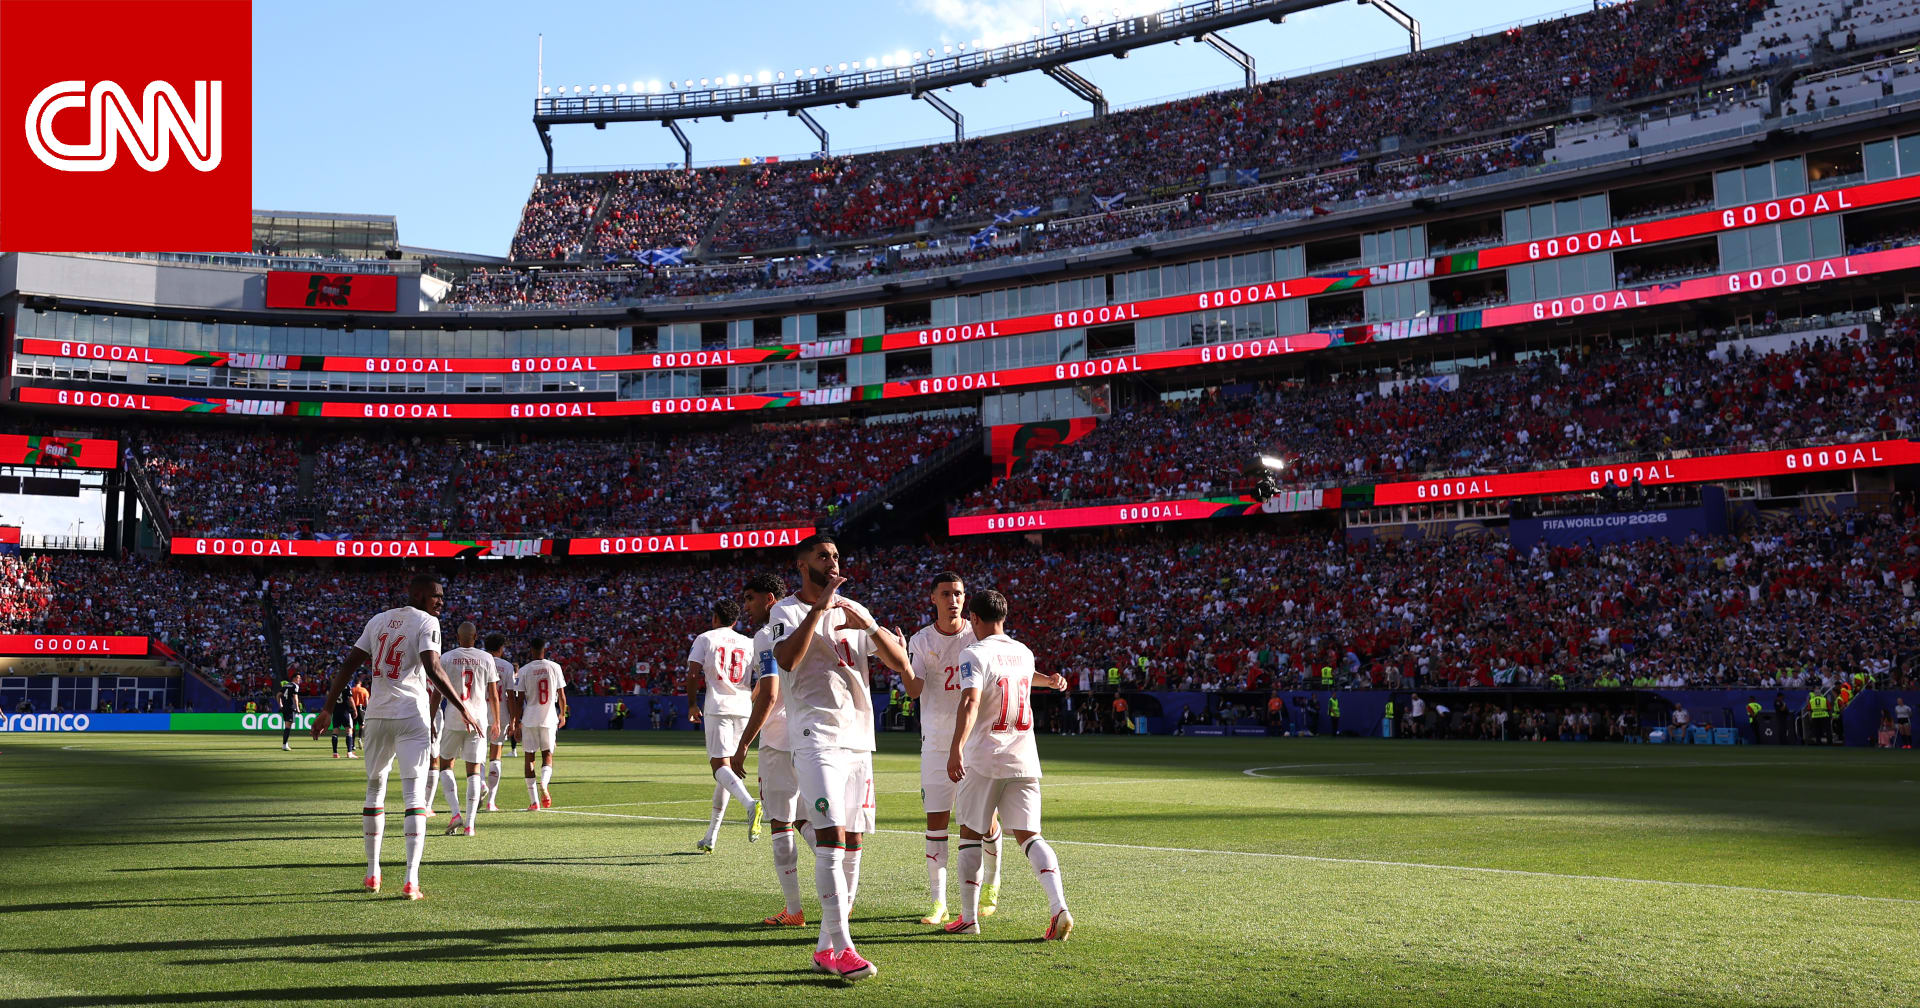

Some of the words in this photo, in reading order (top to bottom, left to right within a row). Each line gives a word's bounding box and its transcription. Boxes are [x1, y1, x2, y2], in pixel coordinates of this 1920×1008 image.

[1724, 192, 1851, 227] GOOOAL
[1530, 228, 1641, 258] GOOOAL
[1729, 258, 1858, 291] GOOOAL
[1200, 283, 1291, 308] GOOOAL
[1534, 291, 1646, 319] GOOOAL
[1055, 304, 1139, 327] GOOOAL
[919, 323, 998, 344] GOOOAL
[61, 343, 152, 361] GOOOAL
[1202, 338, 1294, 361] GOOOAL
[366, 359, 452, 371] GOOOAL
[512, 358, 596, 371] GOOOAL
[655, 352, 734, 367] GOOOAL
[1056, 357, 1141, 379] GOOOAL
[920, 373, 1000, 393] GOOOAL
[59, 391, 150, 409] GOOOAL
[653, 398, 735, 413] GOOOAL
[365, 405, 451, 417] GOOOAL
[511, 404, 595, 417] GOOOAL
[1787, 448, 1882, 468] GOOOAL
[1591, 465, 1674, 484] GOOOAL
[1418, 480, 1492, 497] GOOOAL
[1121, 505, 1182, 519] GOOOAL
[988, 515, 1045, 529] GOOOAL
[1542, 520, 1565, 530] FIFA
[1566, 517, 1604, 528] WORLD
[1605, 516, 1627, 526] CUP
[1628, 513, 1668, 524] 2026
[197, 540, 297, 555] GOOOAL
[601, 536, 688, 552] GOOOAL
[720, 530, 801, 548] GOOOAL
[336, 542, 434, 556] GOOOAL
[35, 639, 109, 650] GOOOAL
[373, 633, 406, 679] 14
[716, 647, 745, 684] 18
[283, 688, 289, 700] 4
[460, 669, 474, 701] 3
[537, 679, 549, 705] 8
[991, 676, 1032, 731] 10
[241, 713, 317, 730] aramc
